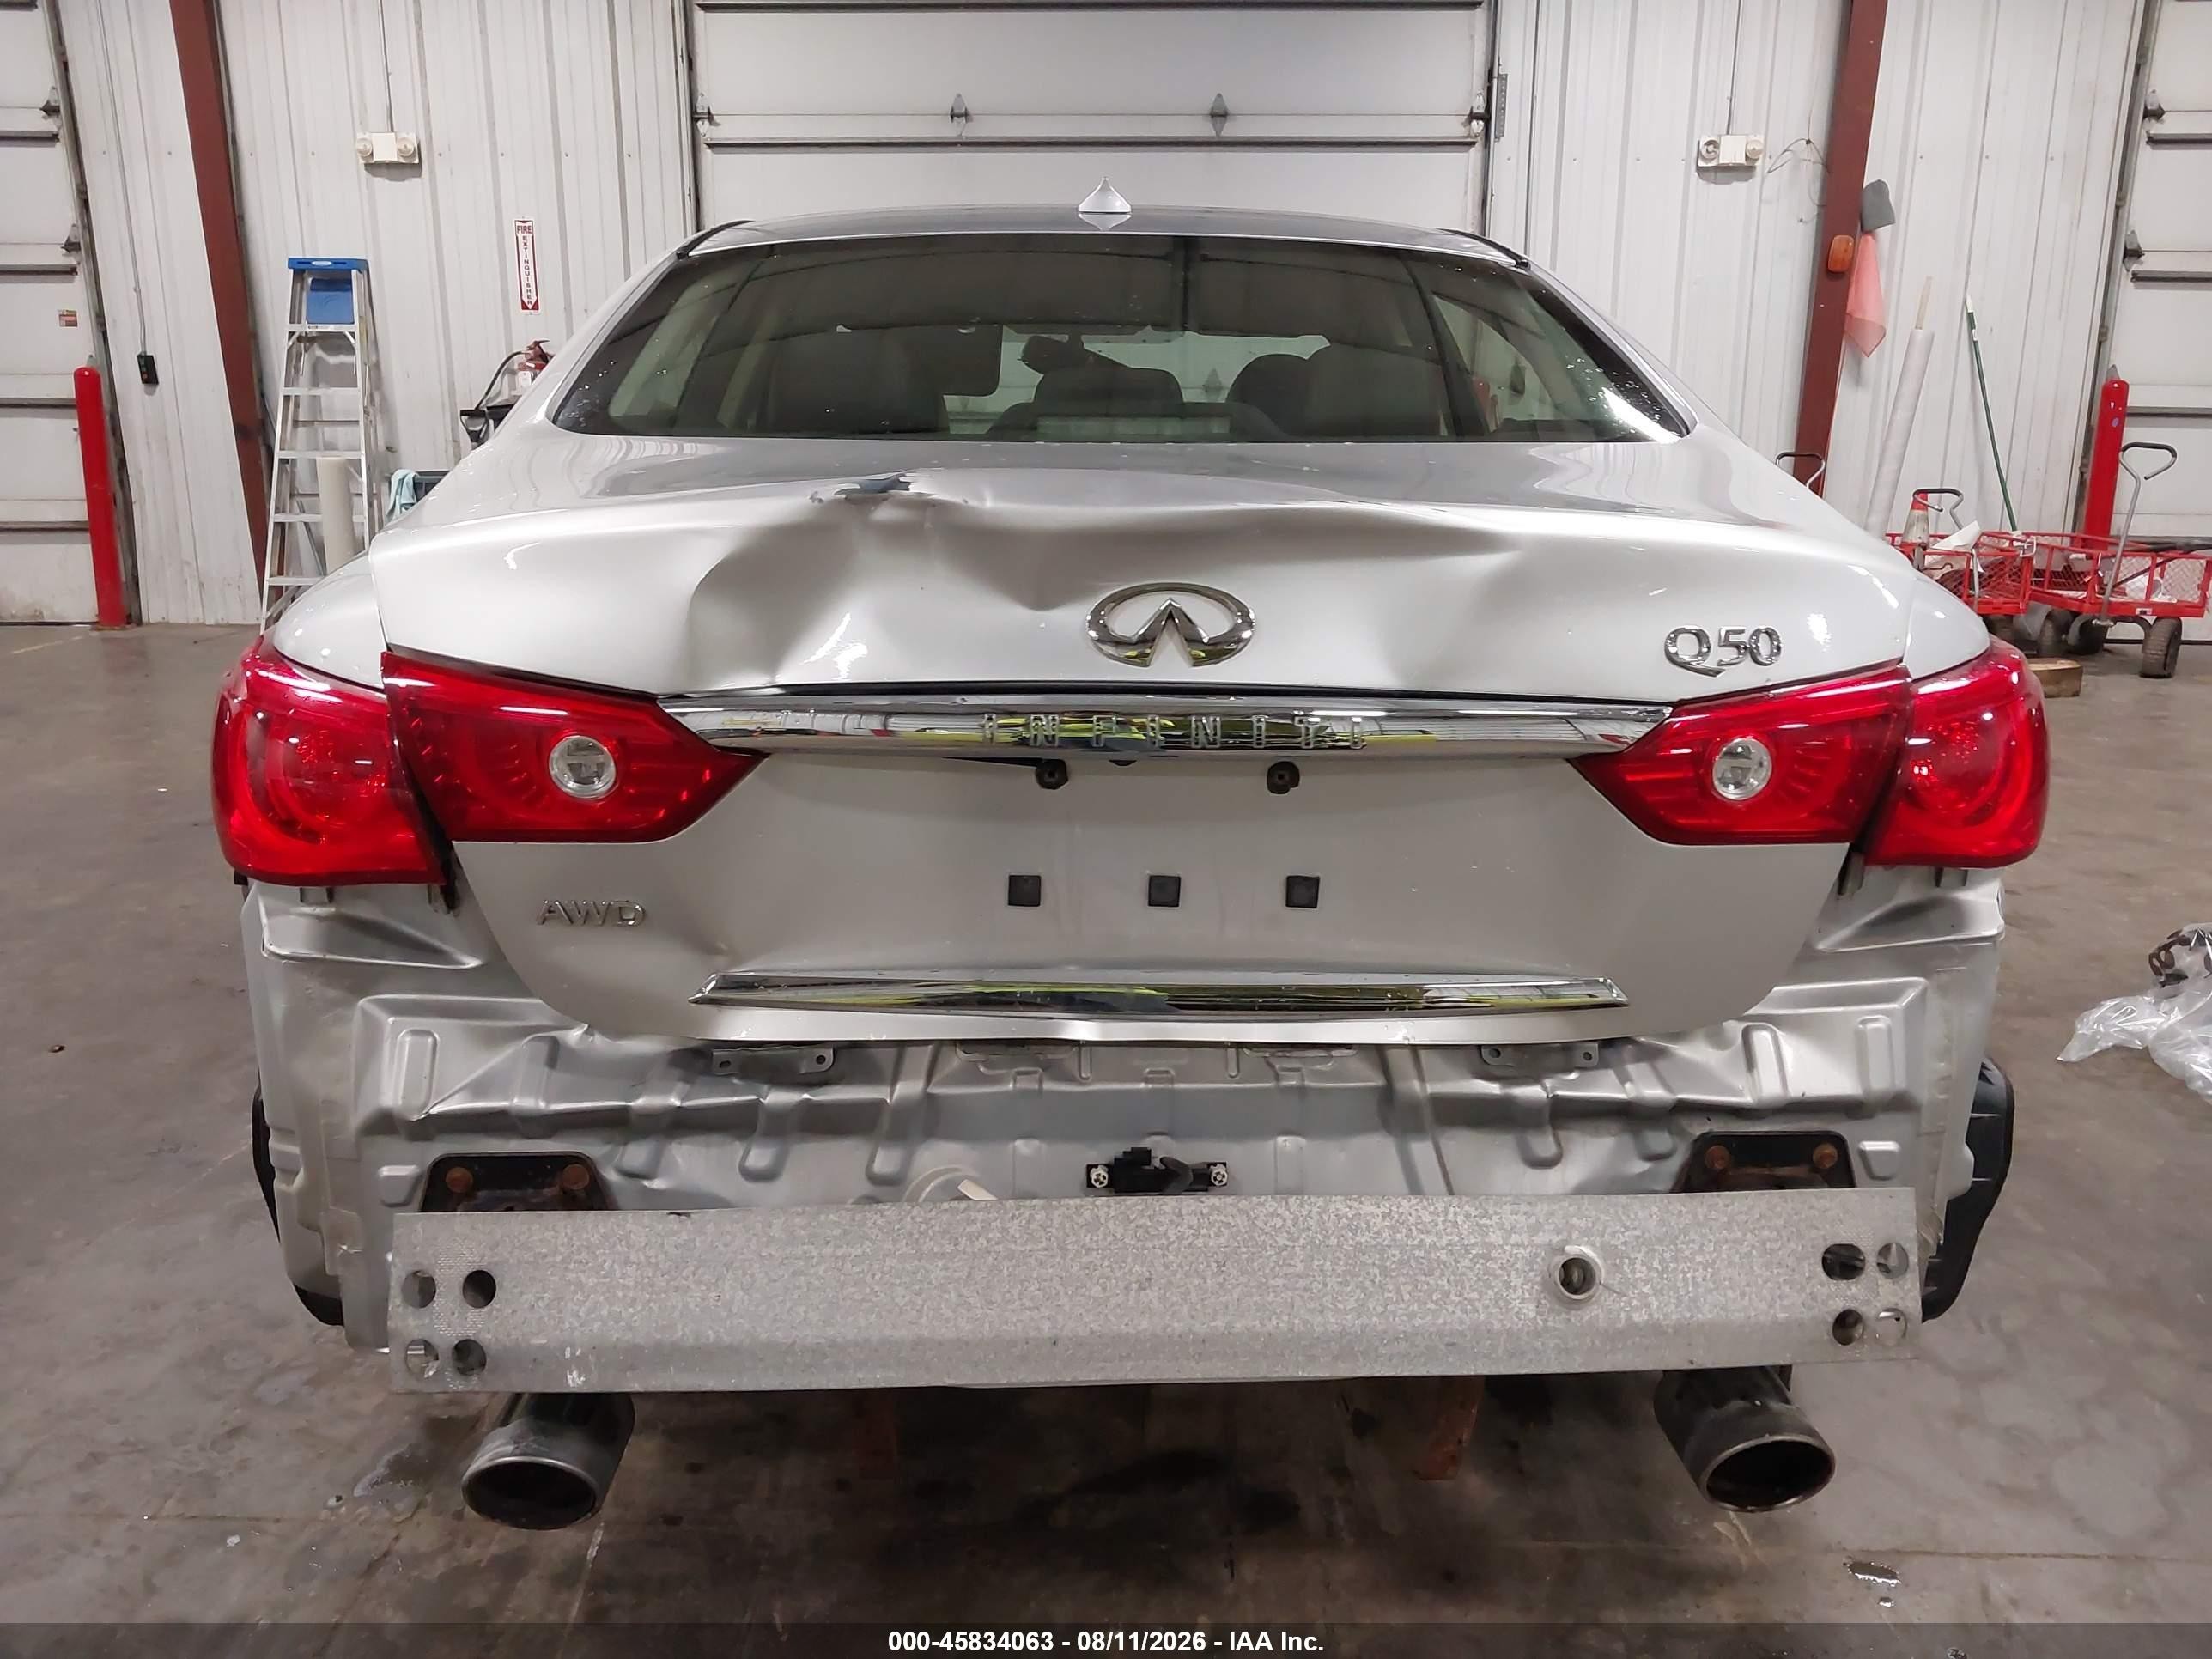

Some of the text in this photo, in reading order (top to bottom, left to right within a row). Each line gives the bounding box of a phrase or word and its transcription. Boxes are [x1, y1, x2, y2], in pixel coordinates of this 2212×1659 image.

[516, 225, 532, 234] FIRE
[522, 235, 533, 306] EXTINGUISHER
[1664, 624, 1782, 678] Q50
[536, 899, 646, 927] AWD
